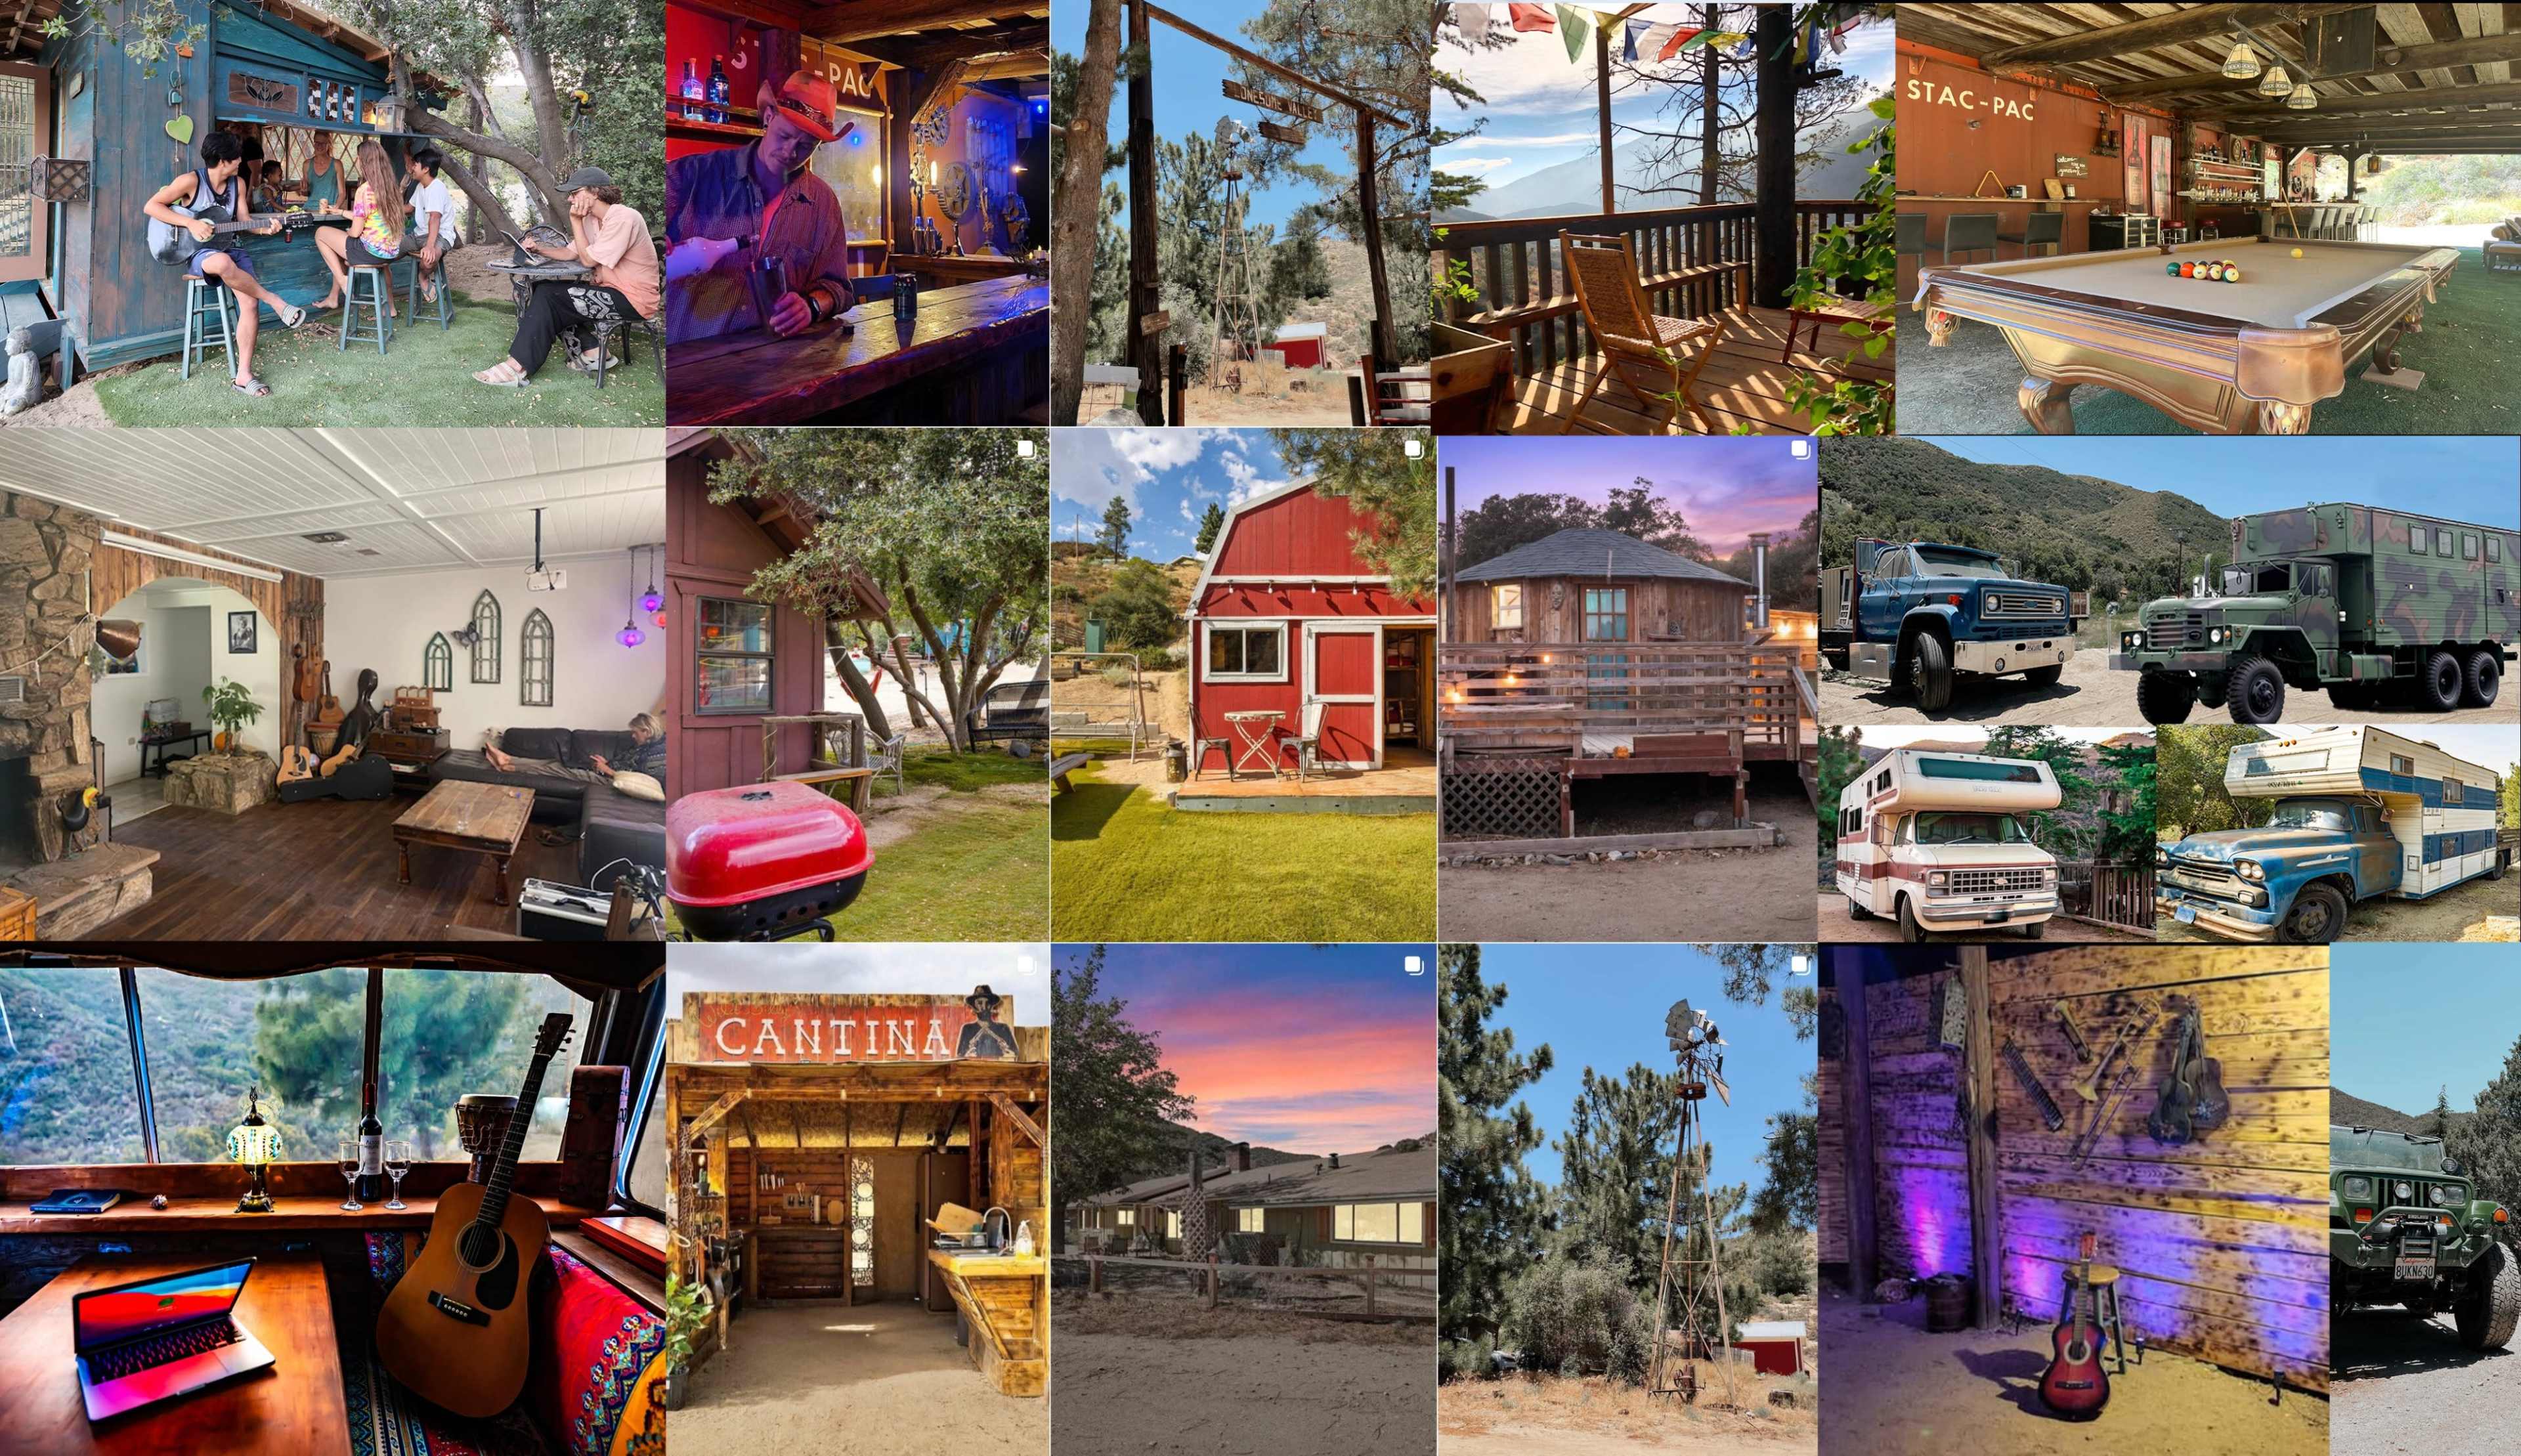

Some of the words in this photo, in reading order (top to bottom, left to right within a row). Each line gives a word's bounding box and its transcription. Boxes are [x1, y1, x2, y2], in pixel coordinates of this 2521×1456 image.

[1907, 79, 2034, 121] STAC-PAC
[715, 1017, 950, 1056] CANTINA
[2396, 1265, 2434, 1277] 8UKN630
